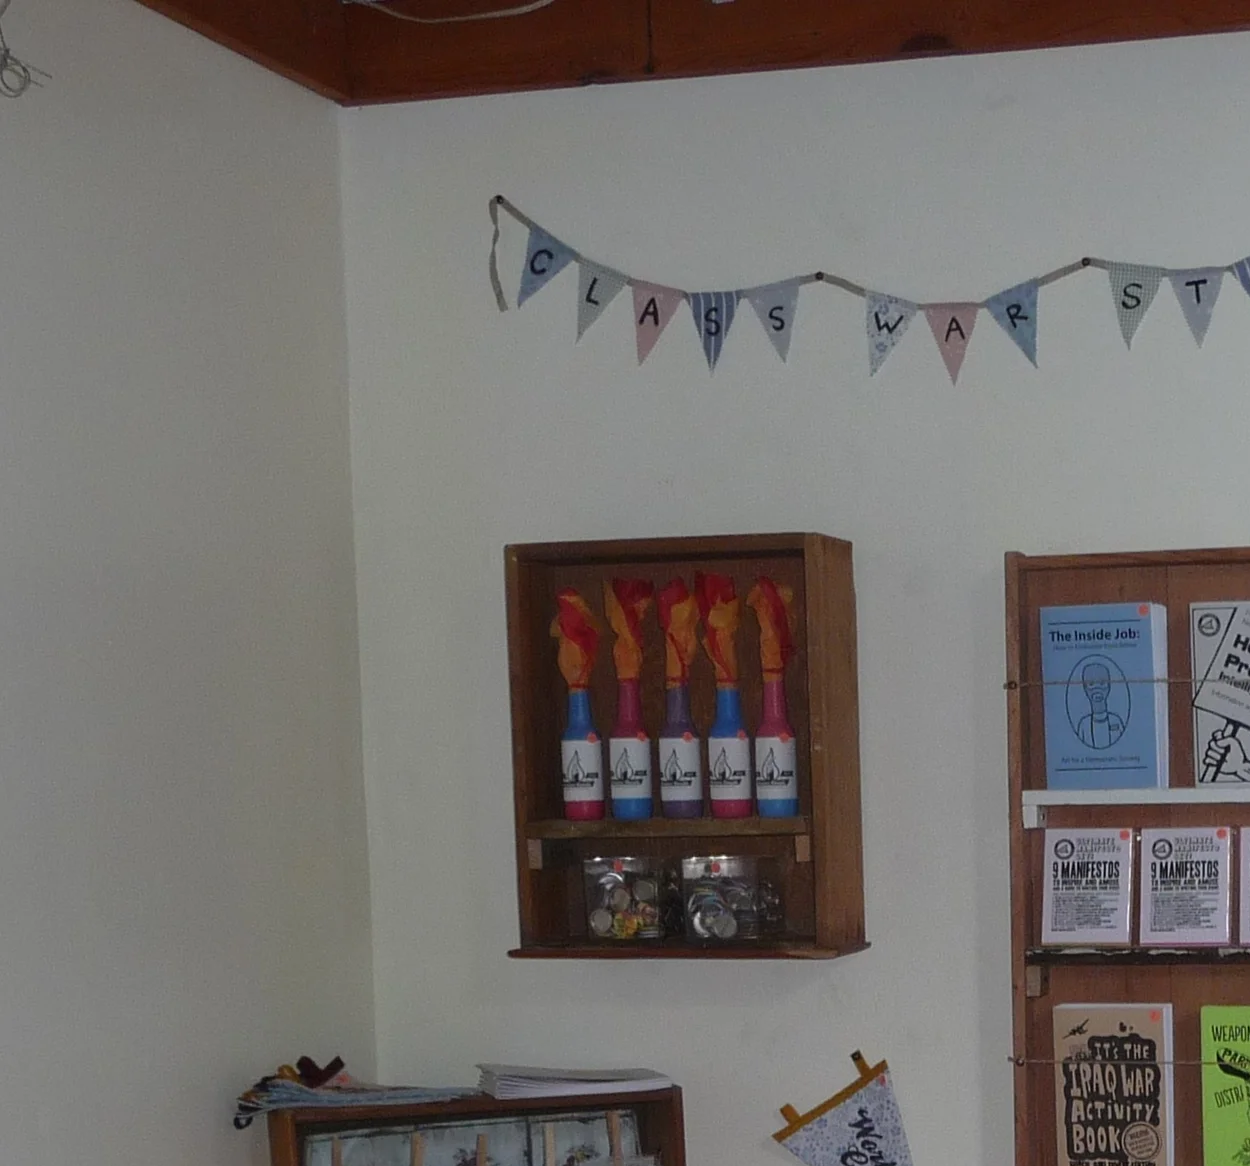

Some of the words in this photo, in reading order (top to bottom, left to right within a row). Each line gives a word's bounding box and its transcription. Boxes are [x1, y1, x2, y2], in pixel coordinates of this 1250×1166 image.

[529, 247, 785, 336] CLASS
[874, 302, 1028, 342] WAR
[1049, 631, 1072, 642] The
[1074, 628, 1112, 641] Inside
[1114, 628, 1140, 639] Job:
[1052, 861, 1059, 879] 9
[1061, 861, 1120, 879] MANIFESTOS
[1151, 861, 1157, 879] 9
[1159, 860, 1219, 879] MANIFESTOS
[1124, 1043, 1149, 1059] THE
[1068, 1063, 1116, 1100] IRAQ
[1121, 1064, 1155, 1098] WAR
[1072, 1123, 1120, 1154] BOOK
